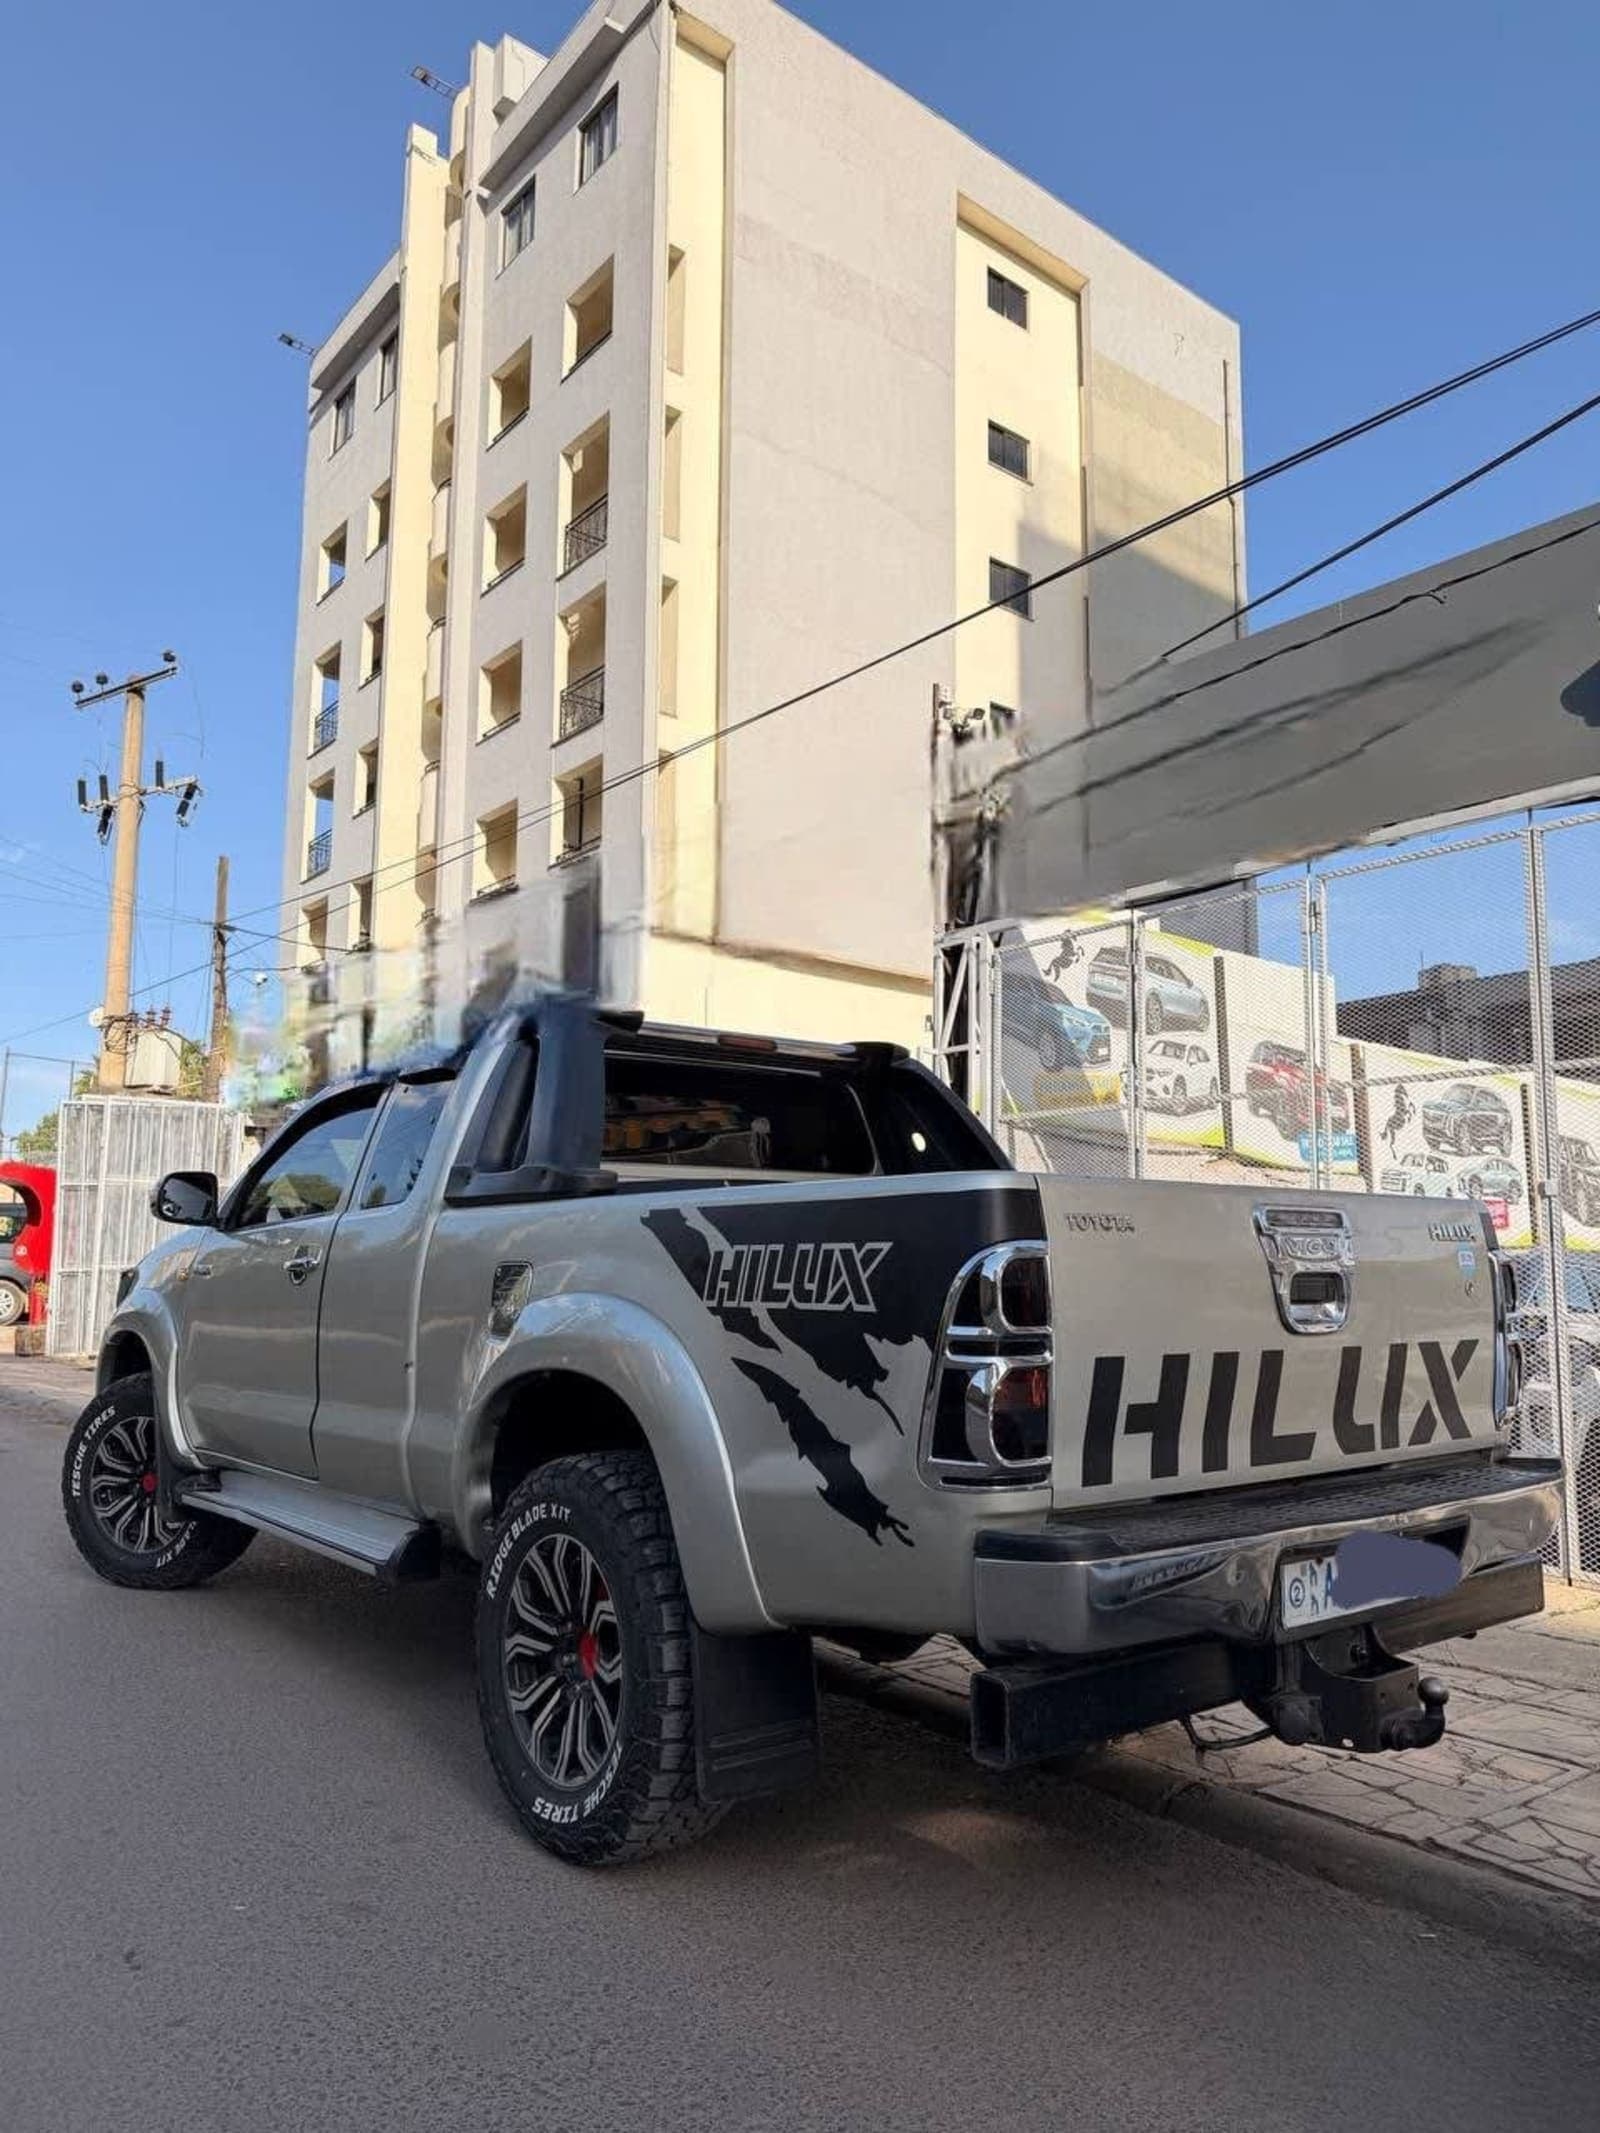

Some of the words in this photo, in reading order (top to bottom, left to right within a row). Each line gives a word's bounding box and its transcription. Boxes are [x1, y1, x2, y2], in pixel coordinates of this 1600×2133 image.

[1065, 1212, 1135, 1233] TOYOTA
[1427, 1223, 1476, 1242] HILUX
[701, 1241, 893, 1312] HILUX
[84, 1406, 116, 1441] TIRES
[1081, 1339, 1479, 1487] HILUX
[486, 1531, 514, 1600] RIDGE
[510, 1503, 548, 1540] BLADE
[531, 1797, 579, 1824] TIRES
